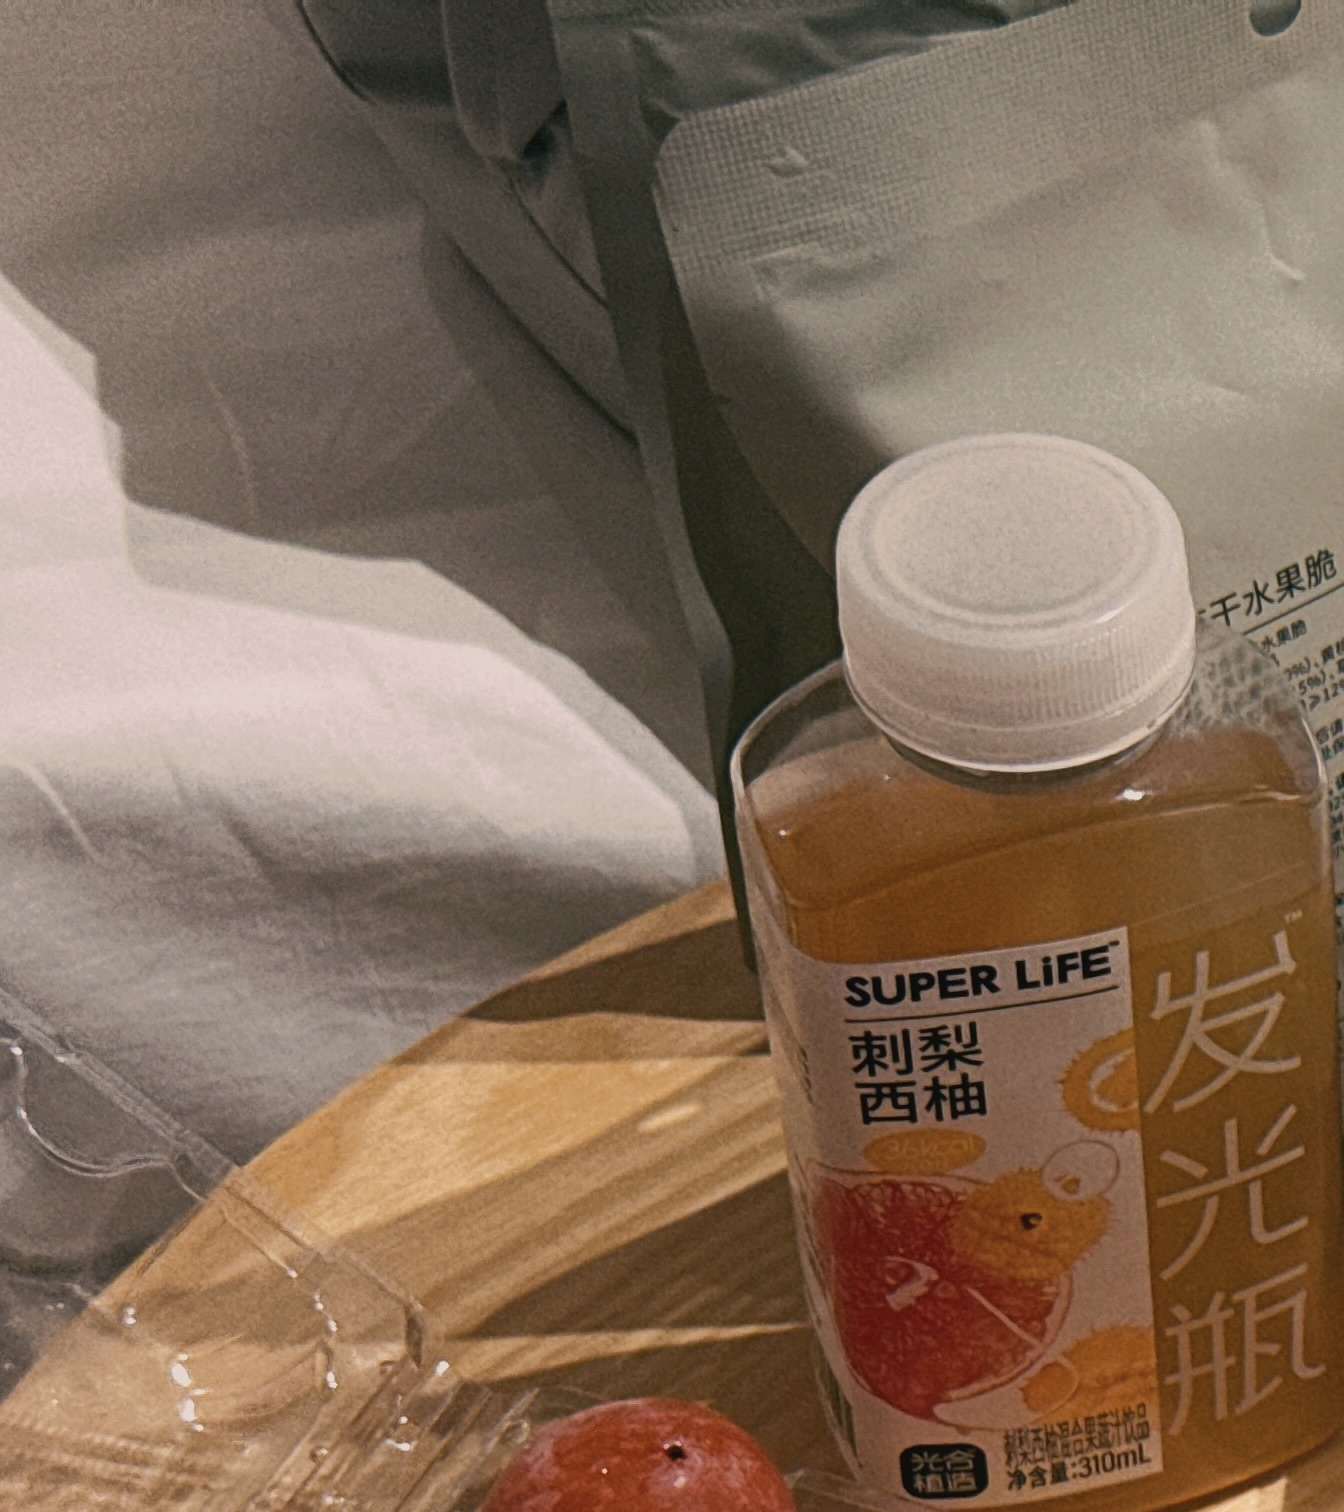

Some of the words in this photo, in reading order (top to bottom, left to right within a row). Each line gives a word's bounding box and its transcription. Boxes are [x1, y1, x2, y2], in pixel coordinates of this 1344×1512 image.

[1198, 549, 1337, 627] 干水果脆
[845, 964, 1001, 1008] SUPER
[848, 1021, 985, 1078] 刺梨
[855, 1072, 988, 1126] 西柚
[1144, 929, 1326, 1436] 发光瓶
[1006, 1442, 1152, 1492] 净含量:310mL
